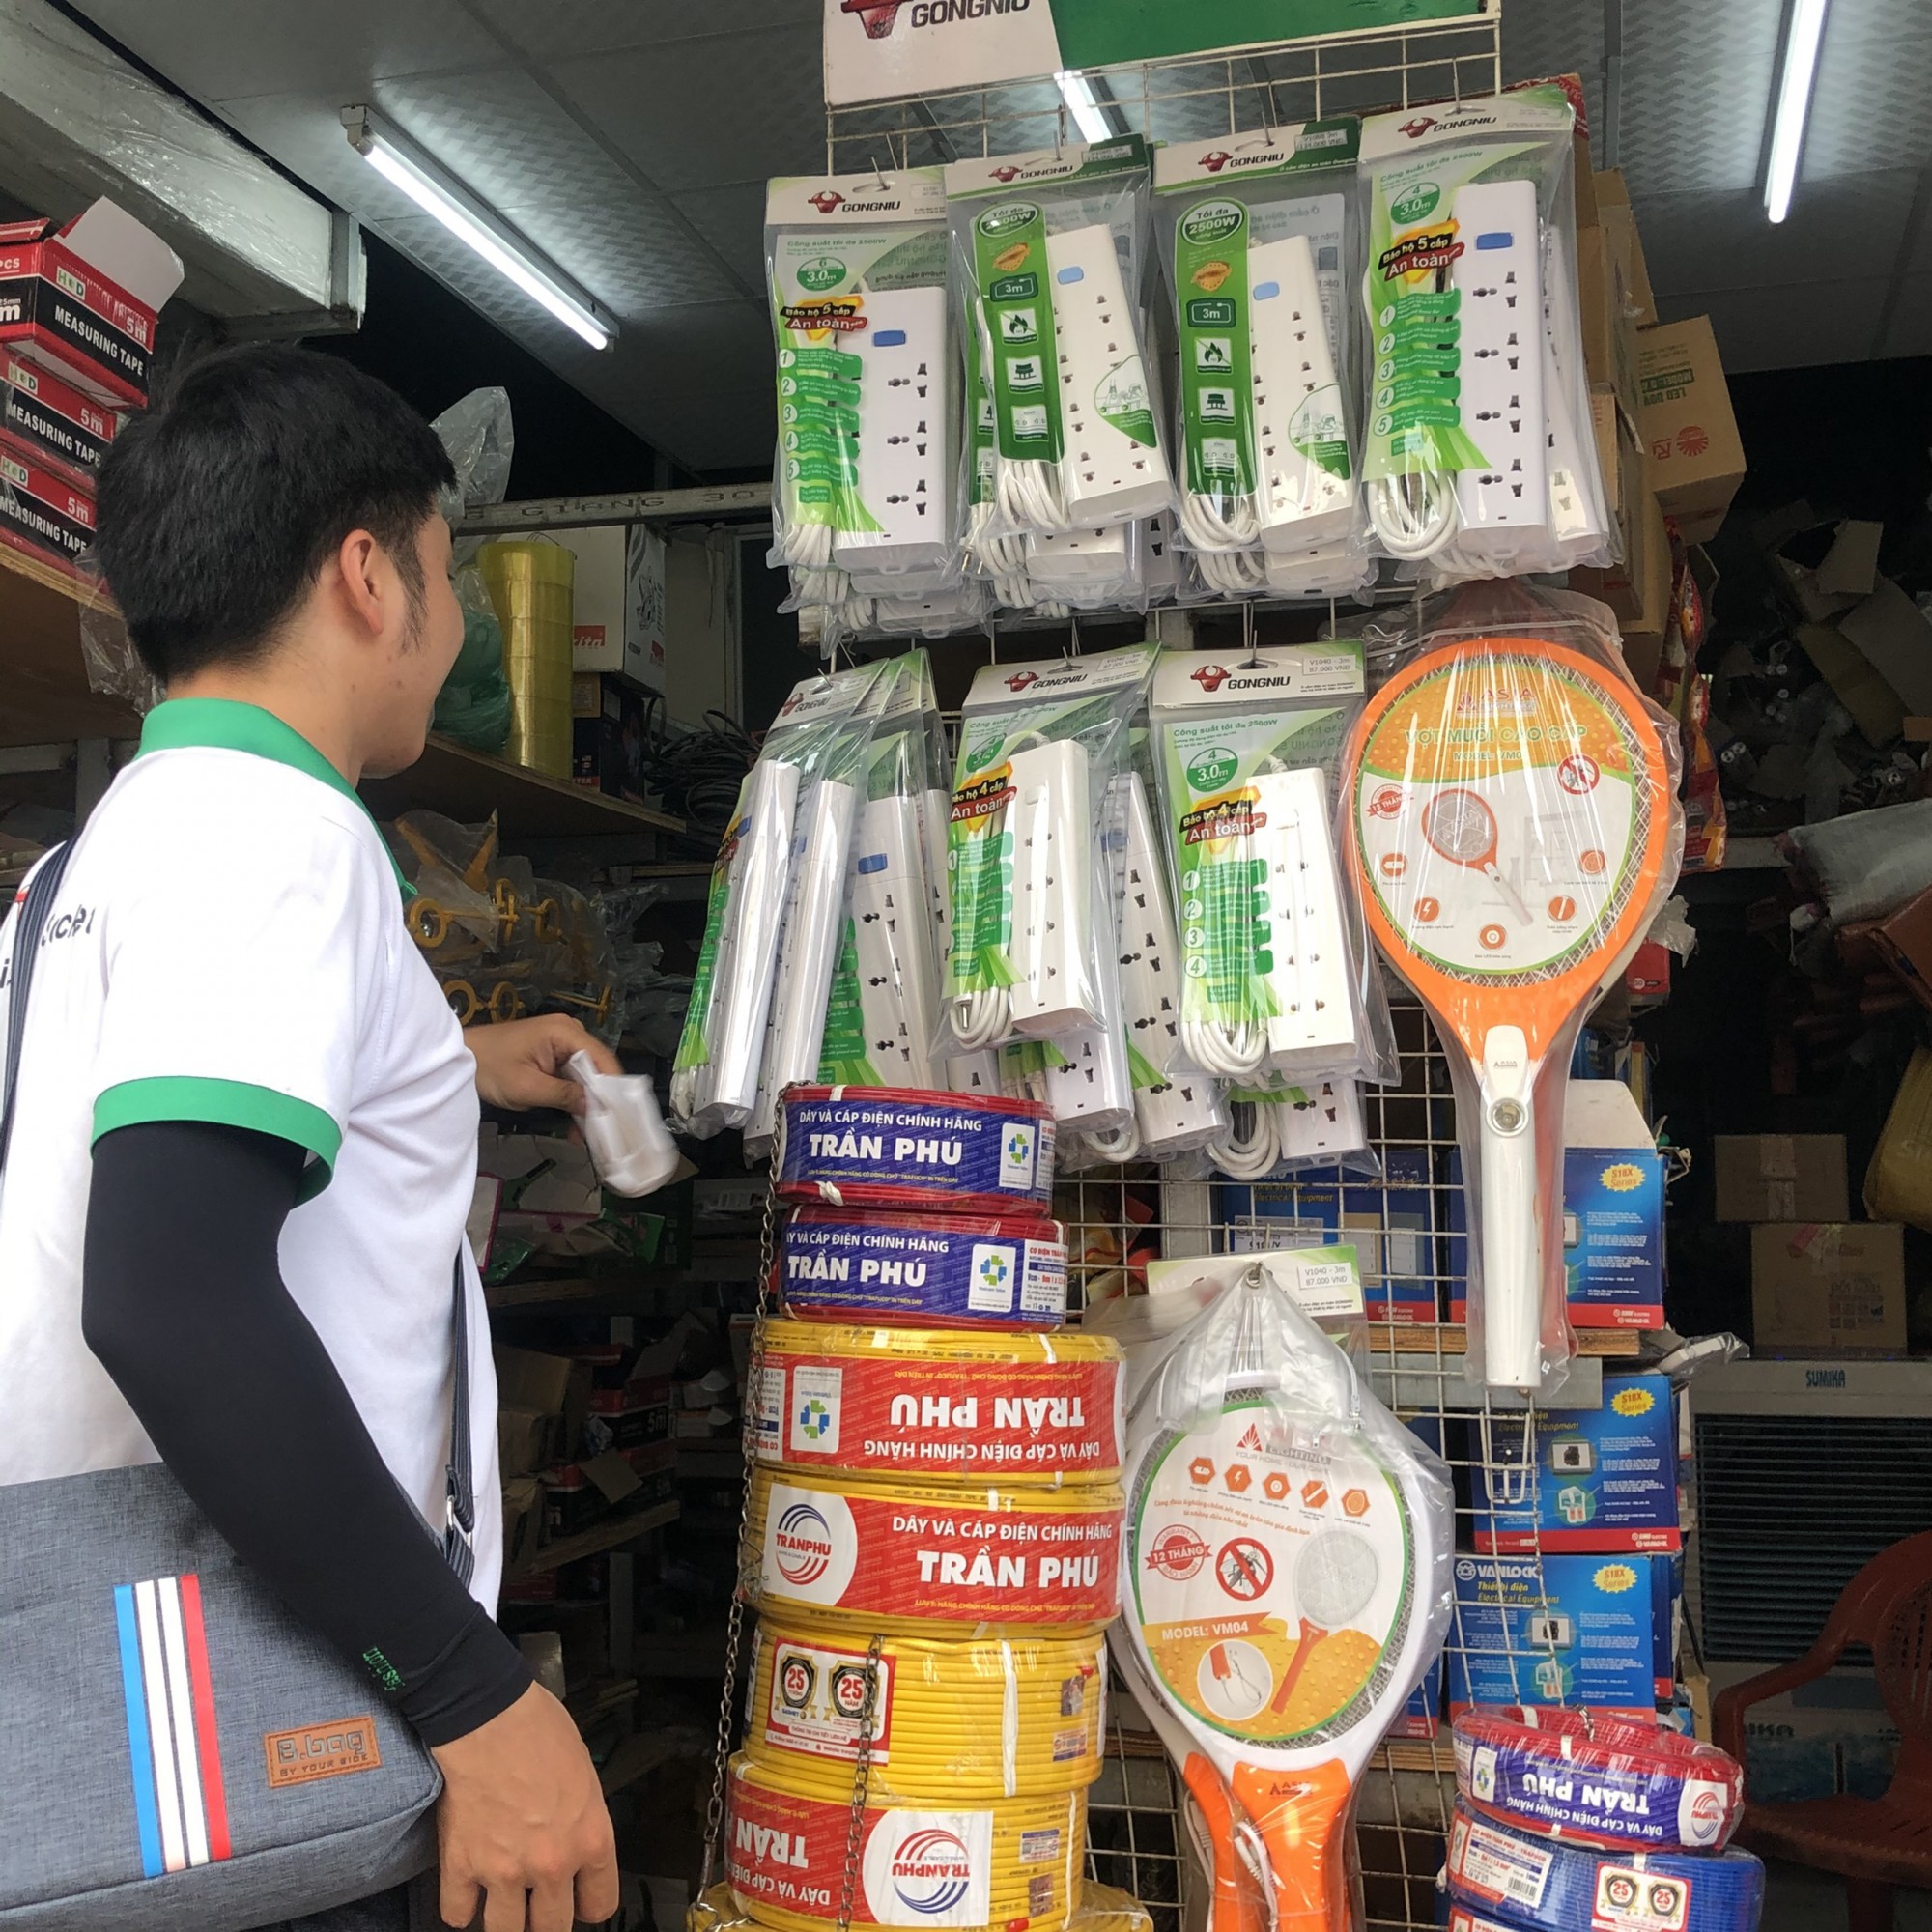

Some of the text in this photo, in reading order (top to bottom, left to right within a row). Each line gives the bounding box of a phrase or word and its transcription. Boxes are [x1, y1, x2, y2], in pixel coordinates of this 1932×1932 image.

[911, 0, 1030, 28] GONGNIU
[1434, 117, 1497, 132] GONGNIU
[1230, 153, 1284, 168] GONGNIU
[1021, 165, 1073, 179] GONGNIU
[842, 201, 900, 213] GONGNIU
[1197, 208, 1229, 219] Tối đa
[1400, 198, 1431, 216] 3.0m
[1189, 216, 1236, 235] 2500W
[1402, 242, 1415, 255] hộ
[1417, 238, 1428, 249] 5
[1388, 253, 1449, 276] An toàn
[807, 270, 836, 282] 3.0m
[1005, 284, 1024, 294] 3m
[823, 303, 832, 314] 5
[1203, 308, 1221, 319] 3m
[127, 317, 148, 343] 5m
[790, 318, 850, 329] An toàn
[55, 305, 144, 376] MEASURING TAPE
[1383, 335, 1391, 352] 2
[781, 352, 789, 365] 1
[1382, 363, 1390, 379] 3
[782, 378, 790, 393] 2
[1380, 389, 1389, 406] 4
[81, 408, 103, 435] 5m
[784, 406, 791, 420] 3
[1379, 418, 1387, 433] 5
[7, 404, 101, 468] MEASURING TAPE
[785, 433, 794, 447] 4
[788, 462, 795, 477] 5
[68, 497, 88, 523] 5m
[0, 496, 86, 553] MEASURING TAPE
[1032, 674, 1088, 689] GONGNIU
[1228, 675, 1291, 690] GONGNIU
[1174, 727, 1198, 737] Công
[1200, 724, 1219, 734] suất
[1235, 721, 1246, 729] đa
[1248, 719, 1278, 727] 2500W
[1208, 750, 1217, 759] 4
[1197, 764, 1229, 781] 3.0m
[980, 783, 987, 795] 4
[951, 797, 1003, 820] An toàn
[1183, 814, 1202, 826] Bảo
[1218, 804, 1228, 815] 4
[1189, 819, 1251, 842] An toàn
[1186, 874, 1194, 888] 1
[1186, 901, 1196, 917] 2
[1190, 930, 1198, 944] 3
[1191, 958, 1200, 973] 4
[800, 1109, 982, 1131] DÂY VÀ CÁP ĐIỆN CHÍNH HÃNG
[810, 1127, 963, 1165] TRẦN PHÚ
[1611, 1168, 1633, 1179] S18X
[1610, 1178, 1637, 1189] Series
[797, 1231, 809, 1244] VÀ
[810, 1232, 830, 1245] CÁP
[832, 1233, 860, 1249] ĐIỆN
[863, 1234, 905, 1249] CHÍNH
[908, 1237, 950, 1253] HÃNG
[787, 1248, 927, 1288] TRẦN PHÚ
[1805, 1370, 1846, 1388] SUMIKA
[1621, 1393, 1643, 1404] S18X
[890, 1394, 1085, 1438] TRẦN PHÚ
[1621, 1403, 1647, 1413] Series
[864, 1440, 1100, 1462] DÂY VÀ CÁP ĐIỆN CHÍNH HÃNG
[893, 1515, 1112, 1545] DÂY VÀ CÁP ĐIỆN CHÍNH HÃNG
[776, 1533, 832, 1556] TRANPHU
[1152, 1546, 1204, 1562] 12 THÁNG
[918, 1544, 1098, 1589] TRẦN PHÚ
[1477, 1565, 1540, 1578] VANLOCK
[1605, 1570, 1625, 1578] S18X
[1510, 1582, 1528, 1592] điện
[1603, 1578, 1629, 1589] Series
[1161, 1621, 1248, 1640] MODEL: VM04
[787, 1668, 863, 1700] 25 25
[280, 1754, 368, 1777] BY YOUR SIDE
[1522, 1774, 1649, 1815] TRẦN PHÚ
[1506, 1797, 1662, 1836] DÂY VÀ CÁP ĐIỆN CHÍNH HÃNG
[736, 1817, 809, 1868] TRẦN
[893, 1863, 970, 1877] TRANPHU
[752, 1874, 830, 1905] DÂY VÀ CÁP
[1613, 1882, 1670, 1905] 25 25
